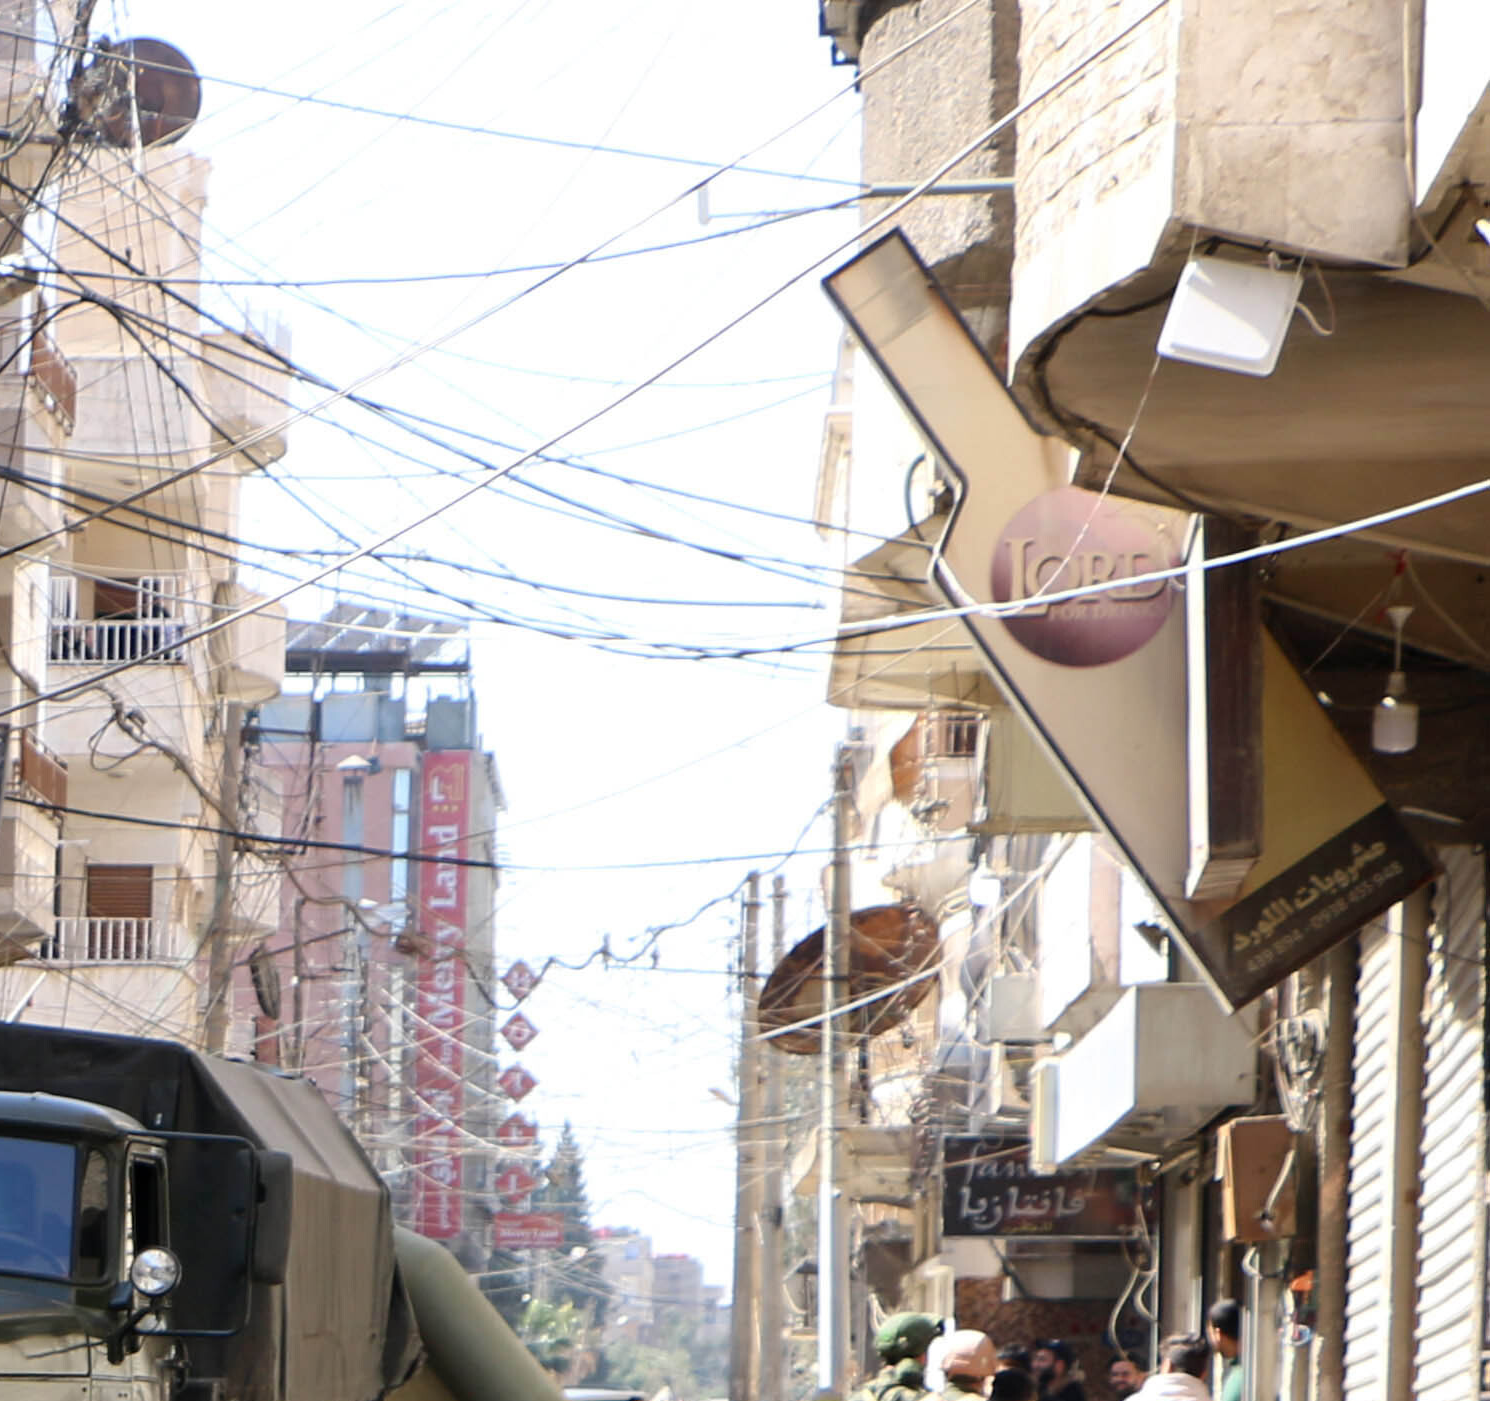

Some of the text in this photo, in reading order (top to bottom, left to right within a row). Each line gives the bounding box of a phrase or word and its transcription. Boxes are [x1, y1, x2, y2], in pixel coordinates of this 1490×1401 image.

[1003, 537, 1169, 619] LORD
[428, 823, 460, 909] Land
[1294, 842, 1387, 909] مشروبات
[427, 921, 463, 1026] Merry
[960, 1185, 1086, 1231] فانتازيا
